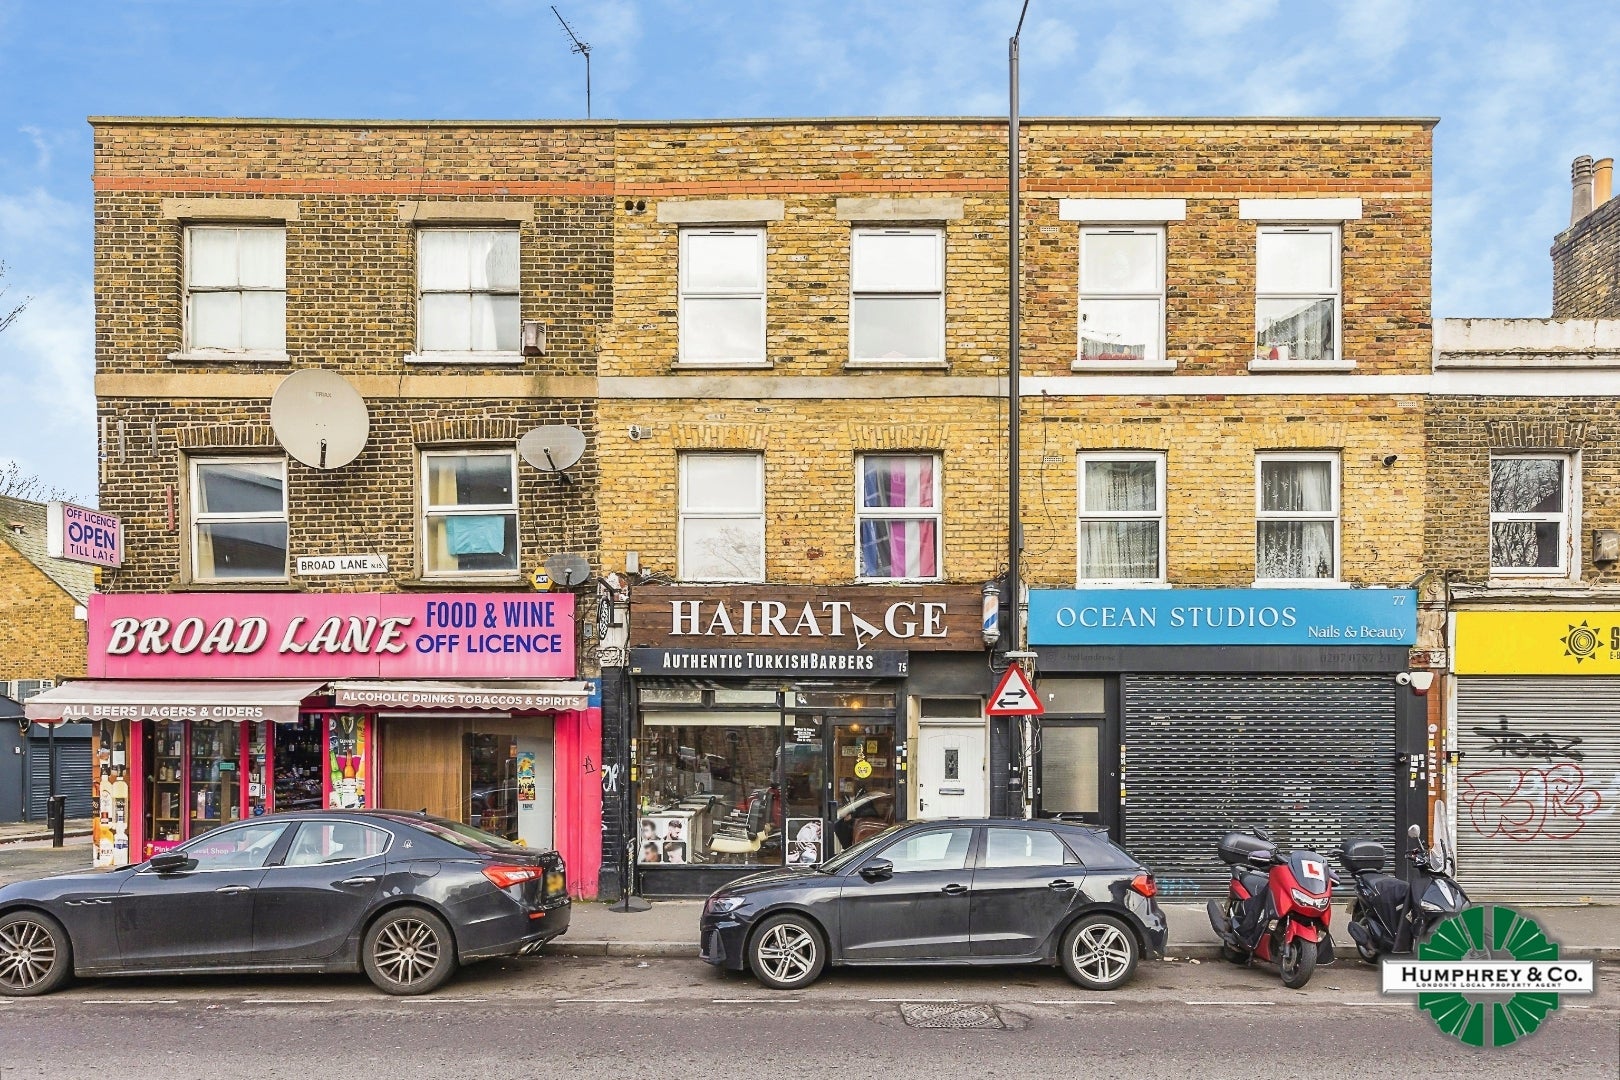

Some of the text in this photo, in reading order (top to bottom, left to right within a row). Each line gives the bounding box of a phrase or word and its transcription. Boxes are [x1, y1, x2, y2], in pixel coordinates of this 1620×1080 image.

[66, 507, 117, 529] OFF LICENCE
[68, 521, 115, 551] OPEN
[70, 543, 115, 563] TILL LATE
[301, 560, 336, 571] BROAD
[340, 559, 368, 570] LANE
[536, 575, 548, 583] ADT
[1392, 595, 1406, 606] 77
[426, 601, 555, 629] FOOD & WINE
[1056, 606, 1298, 628] OCEAN STUDIOS
[106, 616, 416, 655] BROAD LANE
[1308, 625, 1407, 640] Nails & Beauty
[415, 634, 562, 653] OFF LICENCE
[662, 652, 743, 669] AUTHENTIC
[898, 662, 907, 673] 75
[342, 691, 580, 706] ALCOHOLIC DRINKS TOBACCOS & SPIRITS
[62, 705, 263, 718] ALL BEERS LAGERS & CIDERS
[210, 847, 229, 856] Shop
[1307, 863, 1320, 876] L
